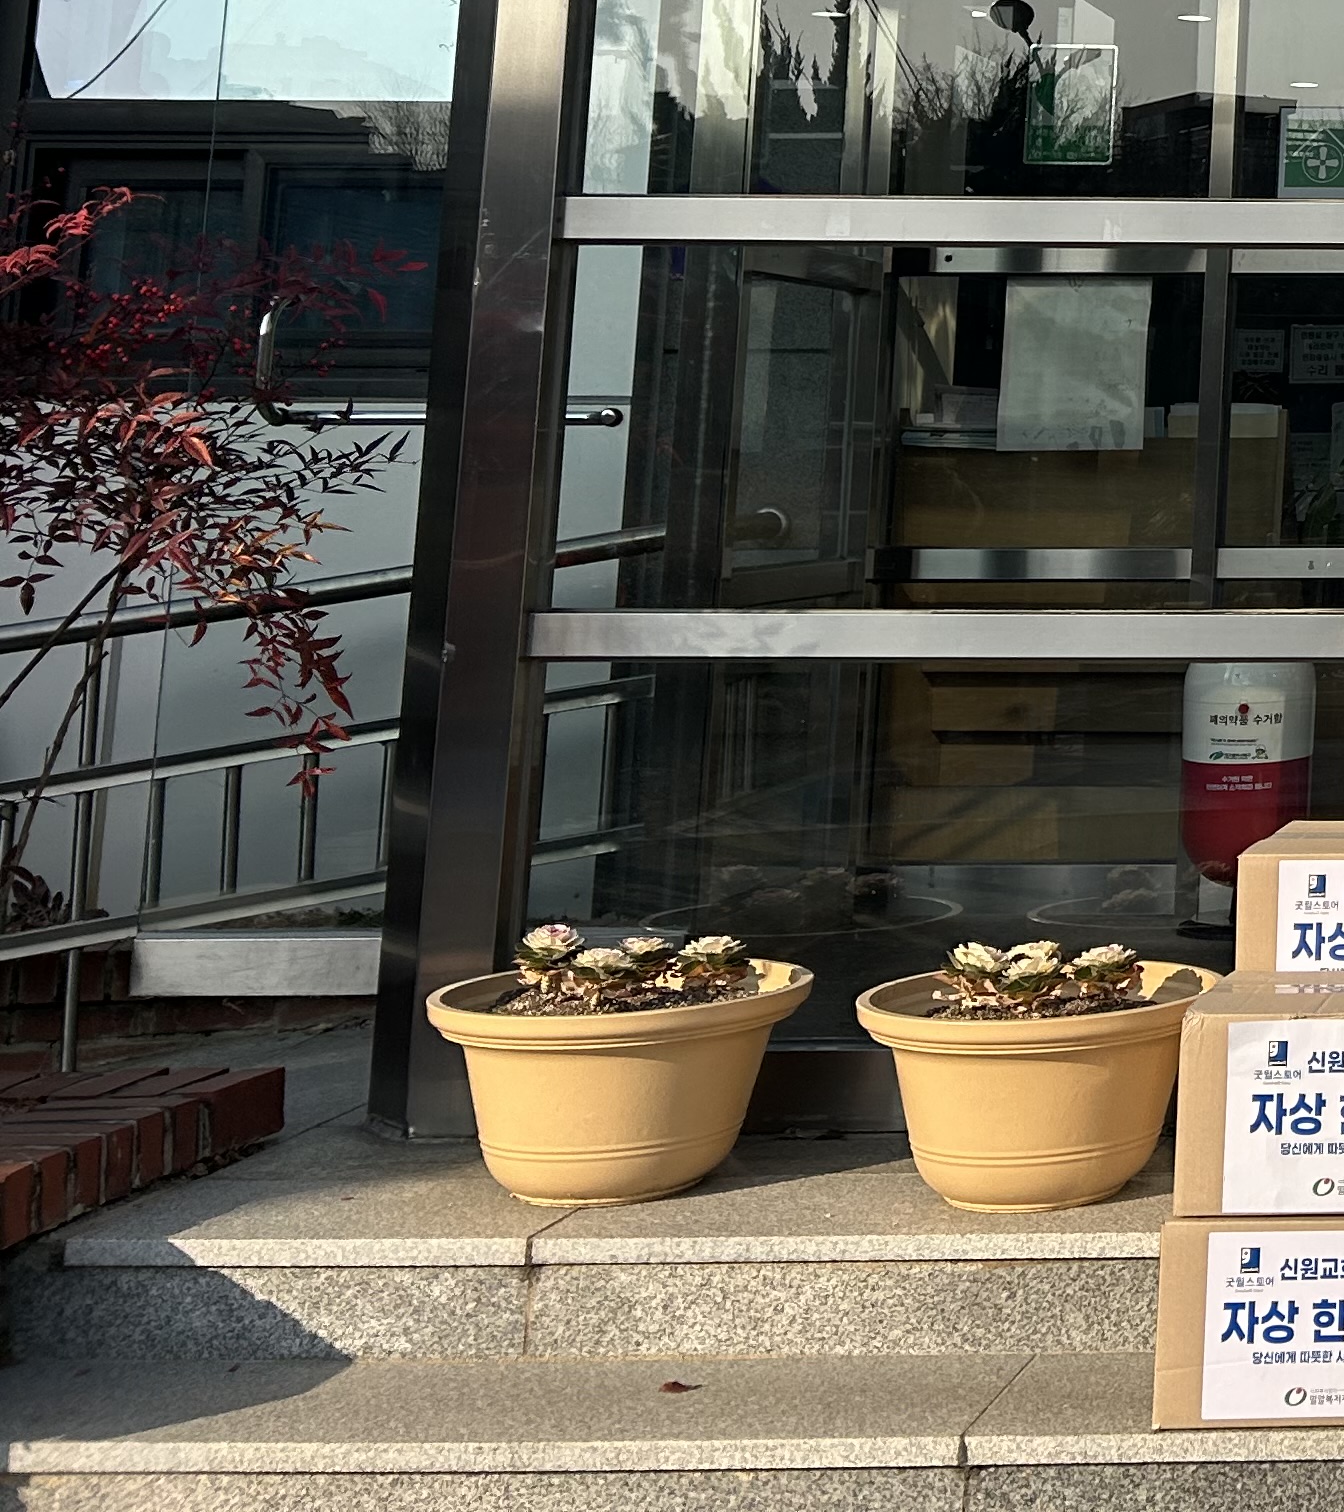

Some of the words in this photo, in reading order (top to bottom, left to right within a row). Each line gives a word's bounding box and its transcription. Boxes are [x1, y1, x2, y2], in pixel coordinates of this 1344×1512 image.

[1250, 1092, 1326, 1136] 자상
[1281, 1142, 1324, 1155] 당신에게
[1221, 1300, 1299, 1344] 자상
[1252, 1351, 1296, 1364] 당신에게
[1300, 1350, 1332, 1364] 따뜻한
